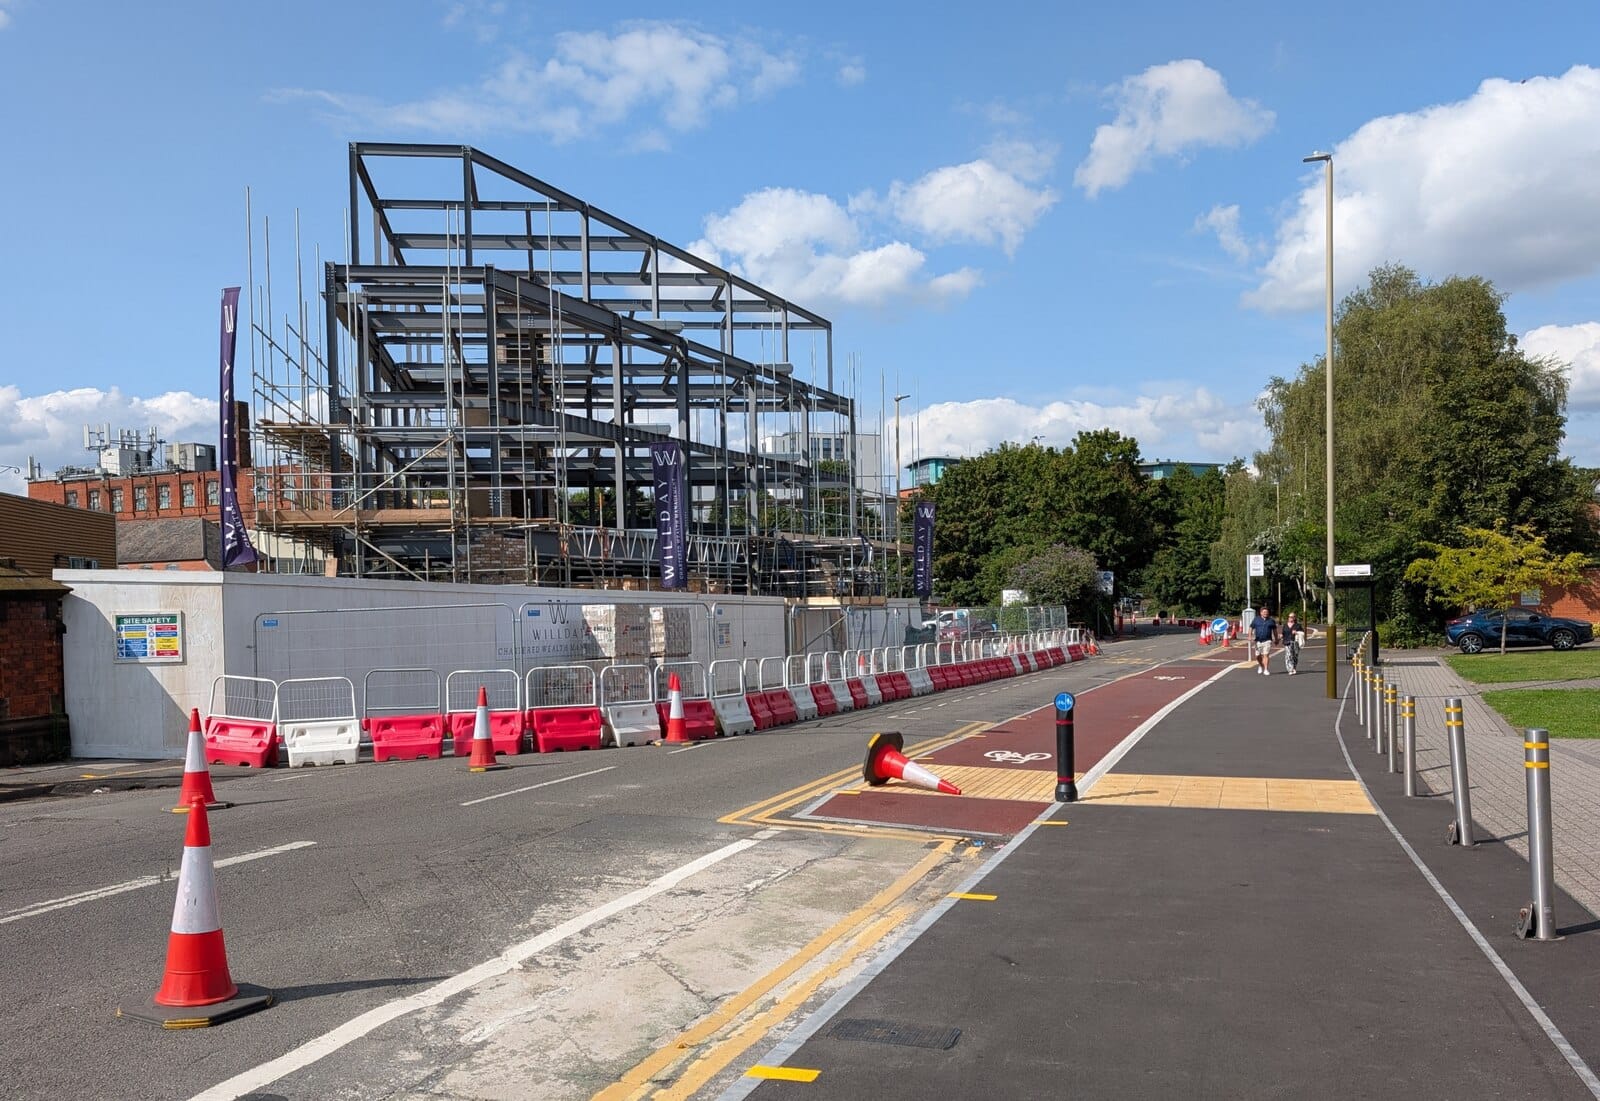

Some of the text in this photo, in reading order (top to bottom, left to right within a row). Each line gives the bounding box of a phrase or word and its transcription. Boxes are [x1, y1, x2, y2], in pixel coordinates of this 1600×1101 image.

[658, 479, 675, 580] WILLDAY
[917, 526, 926, 591] WILLDAY
[123, 616, 171, 624] SITE SAFETY
[498, 645, 540, 655] CHAERED
